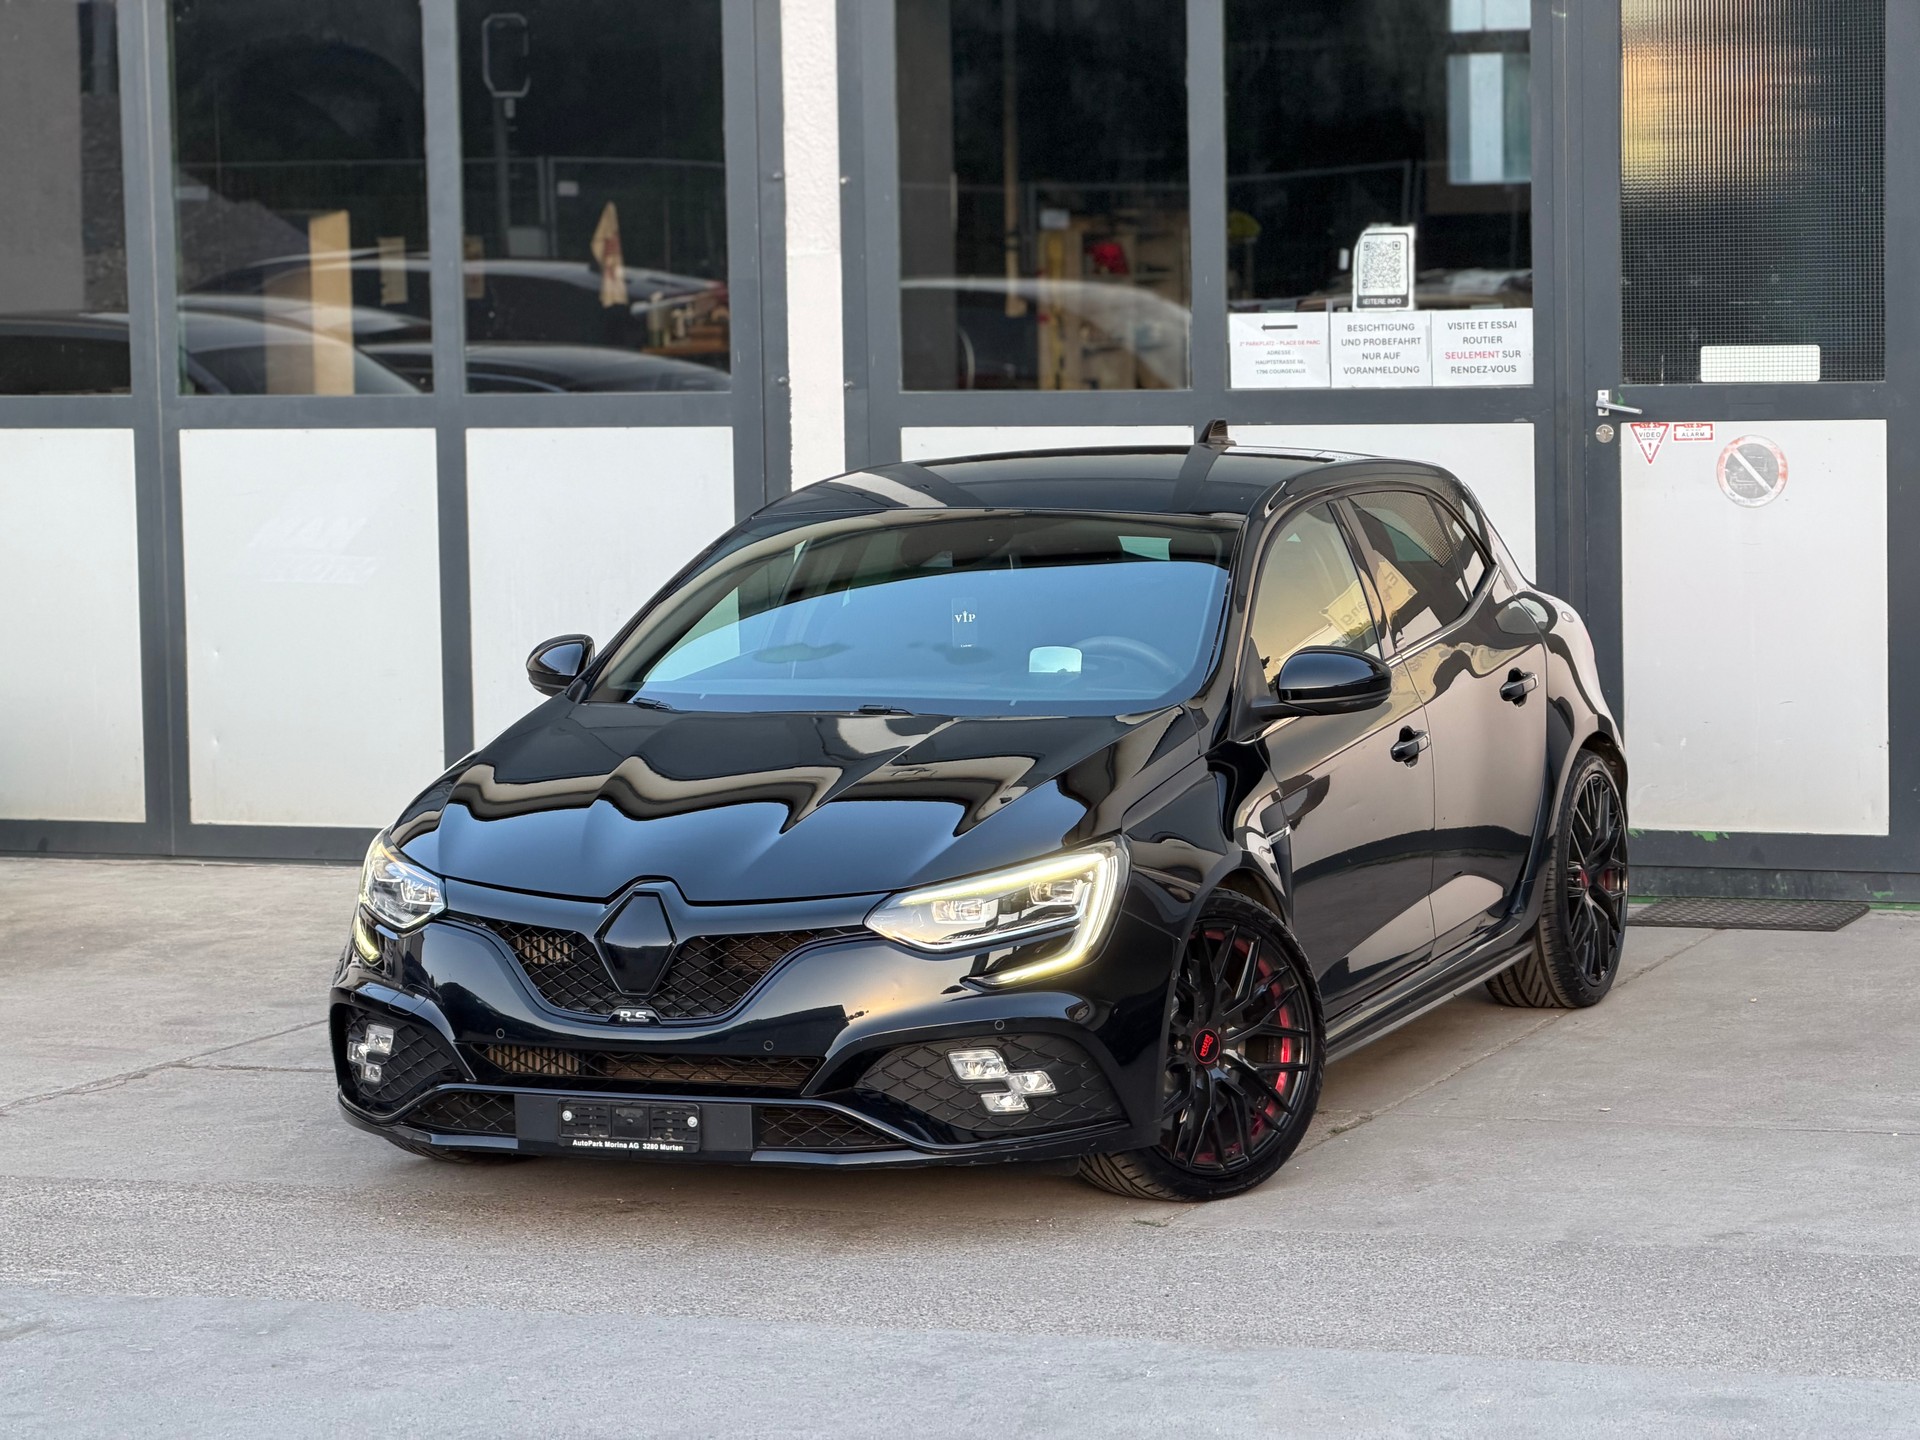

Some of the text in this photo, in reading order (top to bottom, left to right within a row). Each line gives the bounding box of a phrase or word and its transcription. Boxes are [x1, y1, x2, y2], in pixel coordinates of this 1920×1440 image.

[1347, 323, 1415, 332] BESICHTIGUNG
[1447, 320, 1517, 331] VISITE ET ESSAI
[1341, 337, 1421, 346] UND PROBEFAHRT
[1463, 336, 1503, 345] ROUTIER
[1362, 352, 1401, 360] NUR AUF
[1445, 350, 1521, 360] SEULEMENT SUR
[1343, 365, 1420, 375] VORANMELDUNG
[1451, 365, 1517, 374] RENDEZ-VOUS
[954, 610, 976, 623] VIP
[572, 1139, 603, 1148] AutoPark
